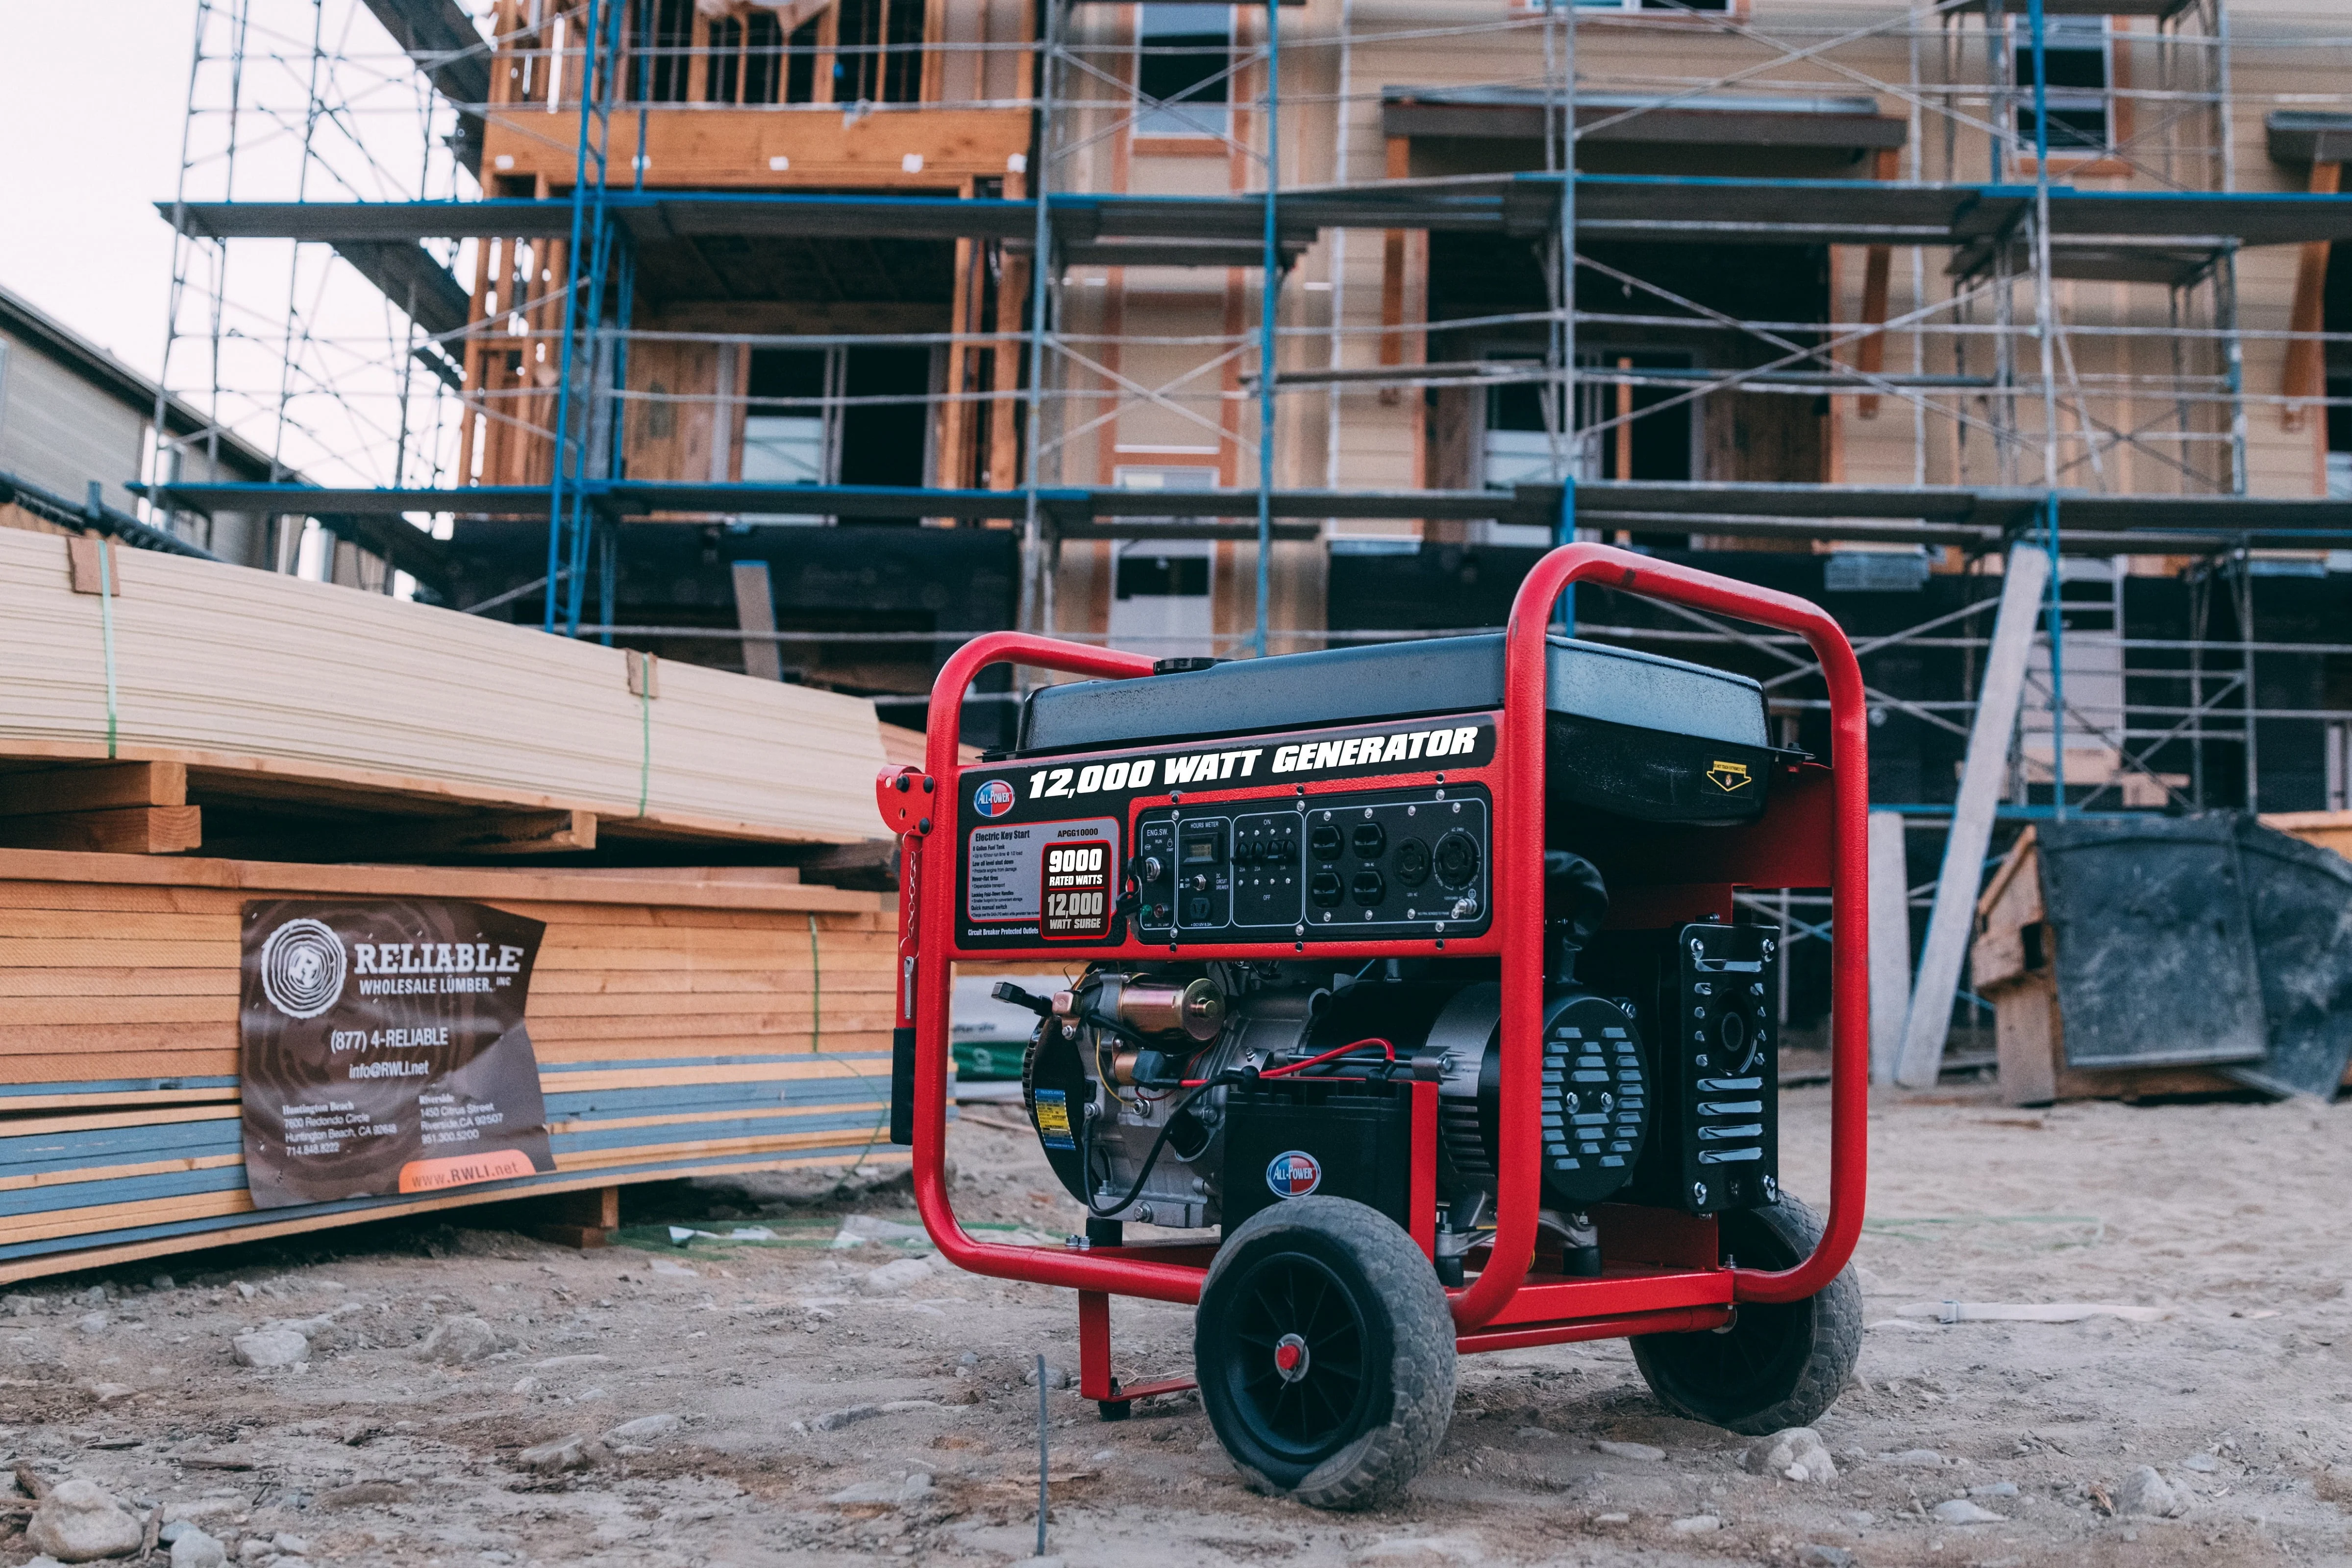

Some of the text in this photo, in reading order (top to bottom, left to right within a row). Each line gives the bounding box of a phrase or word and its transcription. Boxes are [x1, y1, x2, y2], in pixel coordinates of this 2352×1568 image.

[1029, 727, 1479, 799] 12,000 WATT GENERATOR
[975, 830, 1030, 842] Electric Key Start
[1057, 828, 1098, 837] APGG10000
[1147, 828, 1168, 836] ENG.SW.
[1049, 848, 1103, 873] 9000
[1049, 874, 1103, 886] RATED WATTS
[1048, 892, 1103, 919] 12,000
[1049, 918, 1101, 930] WATT SURGE
[354, 943, 524, 974] RELIABLE
[359, 979, 437, 996] WHOLESALE
[331, 1028, 448, 1054] (877) 4-RELIABLE
[349, 1060, 429, 1079] info@RWLI.net
[467, 1102, 495, 1114] Street
[305, 1115, 344, 1127] Redondo
[345, 1113, 370, 1124] Circle
[459, 1117, 474, 1127] CA
[285, 1130, 327, 1143] Huntington
[358, 1126, 372, 1137] CA
[412, 1162, 519, 1188] www.RWLI.net
[1273, 1165, 1313, 1180] ALL-POWER
